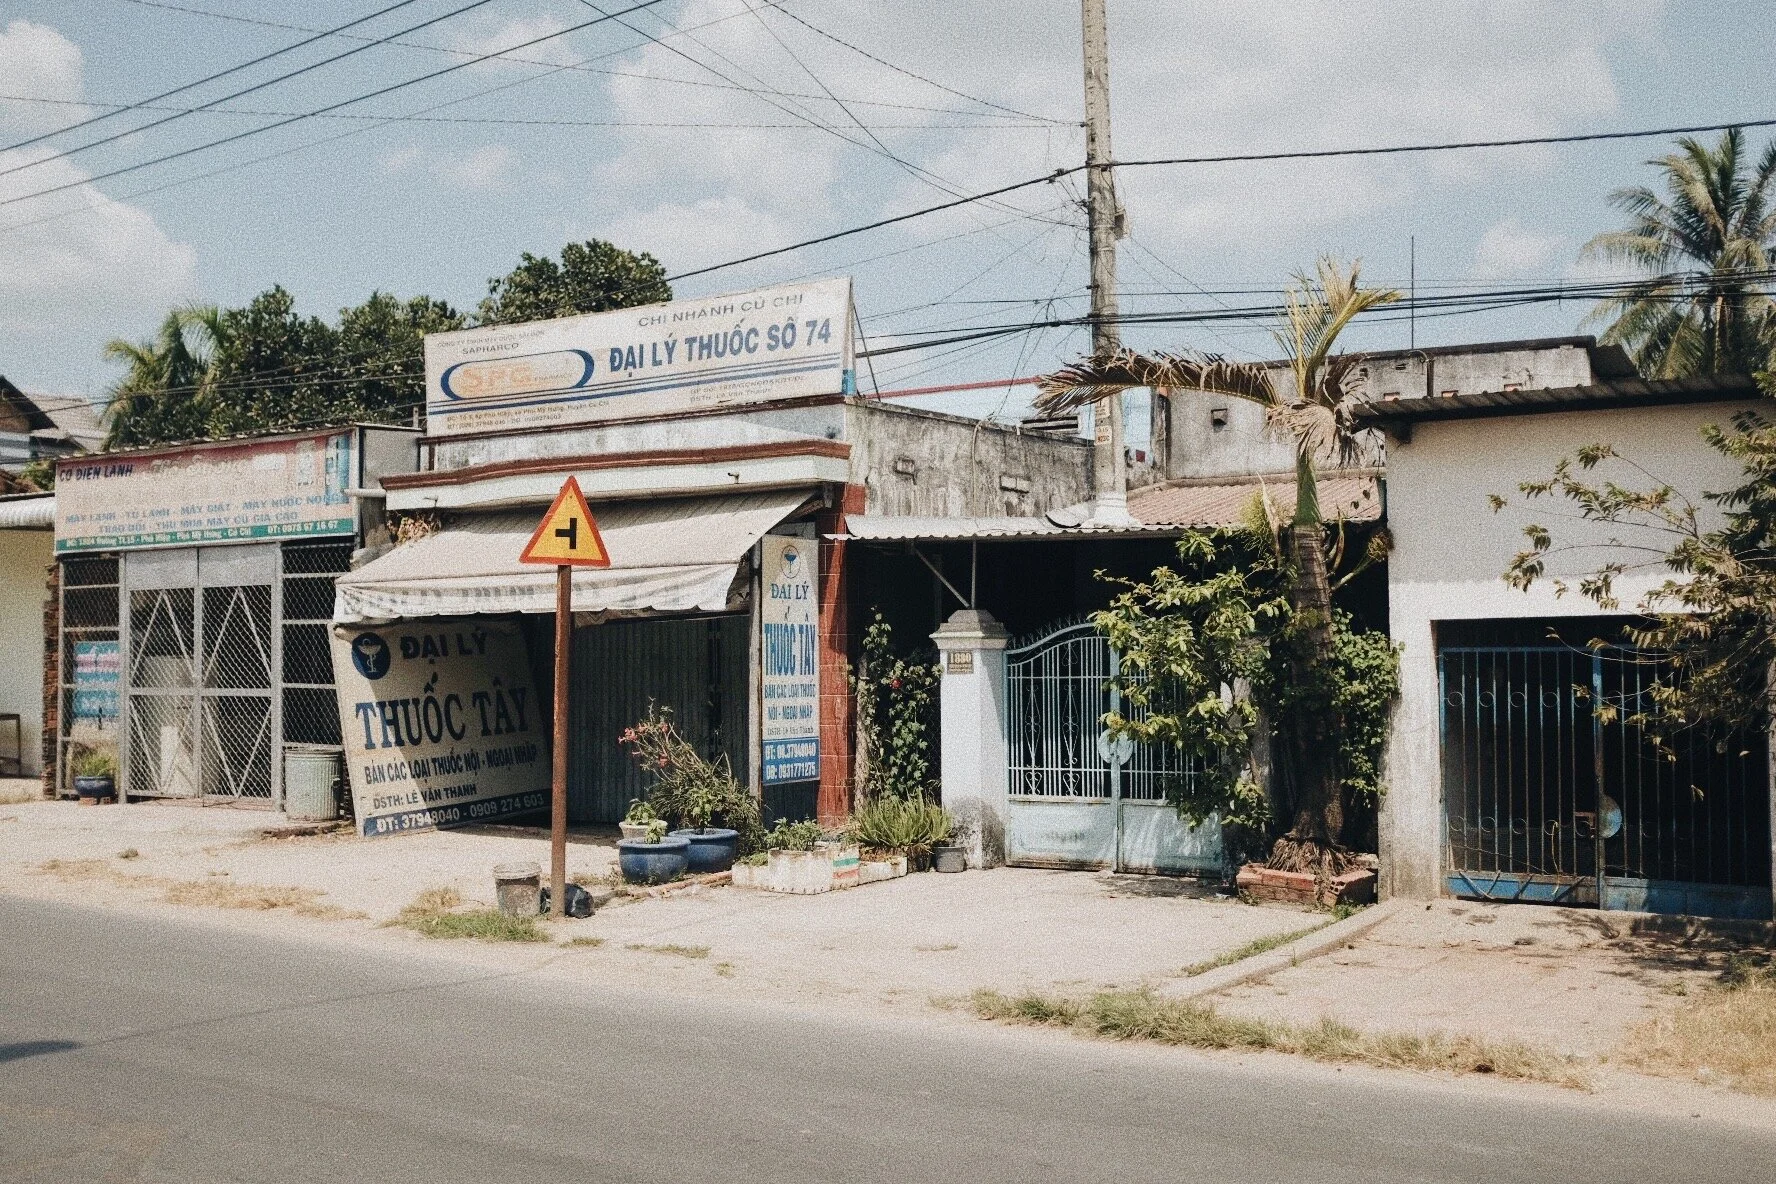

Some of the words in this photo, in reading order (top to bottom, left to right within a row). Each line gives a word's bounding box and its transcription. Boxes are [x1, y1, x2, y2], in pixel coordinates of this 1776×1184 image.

[638, 315, 667, 327] CHI
[774, 294, 803, 308] CHI
[463, 342, 519, 354] SAPHARCO
[609, 343, 644, 378] ĐẠI
[652, 332, 678, 367] LÝ
[685, 317, 759, 362] THUỐC
[805, 317, 832, 347] 74
[795, 580, 809, 600] LÝ
[400, 633, 449, 665] ĐẠI
[764, 605, 796, 676] THUỐC
[798, 612, 816, 676] TÂY
[355, 671, 466, 750] THUỐC
[472, 677, 529, 737] TÂY
[364, 759, 385, 785] BÁN
[387, 757, 407, 783] CÁC
[408, 758, 431, 783] LOẠI
[432, 747, 463, 776] THUỐC
[464, 748, 480, 777] NỘI
[443, 783, 477, 799] THANH
[402, 808, 460, 829] 37948040
[500, 796, 522, 812] 274
[524, 793, 545, 808] 603
